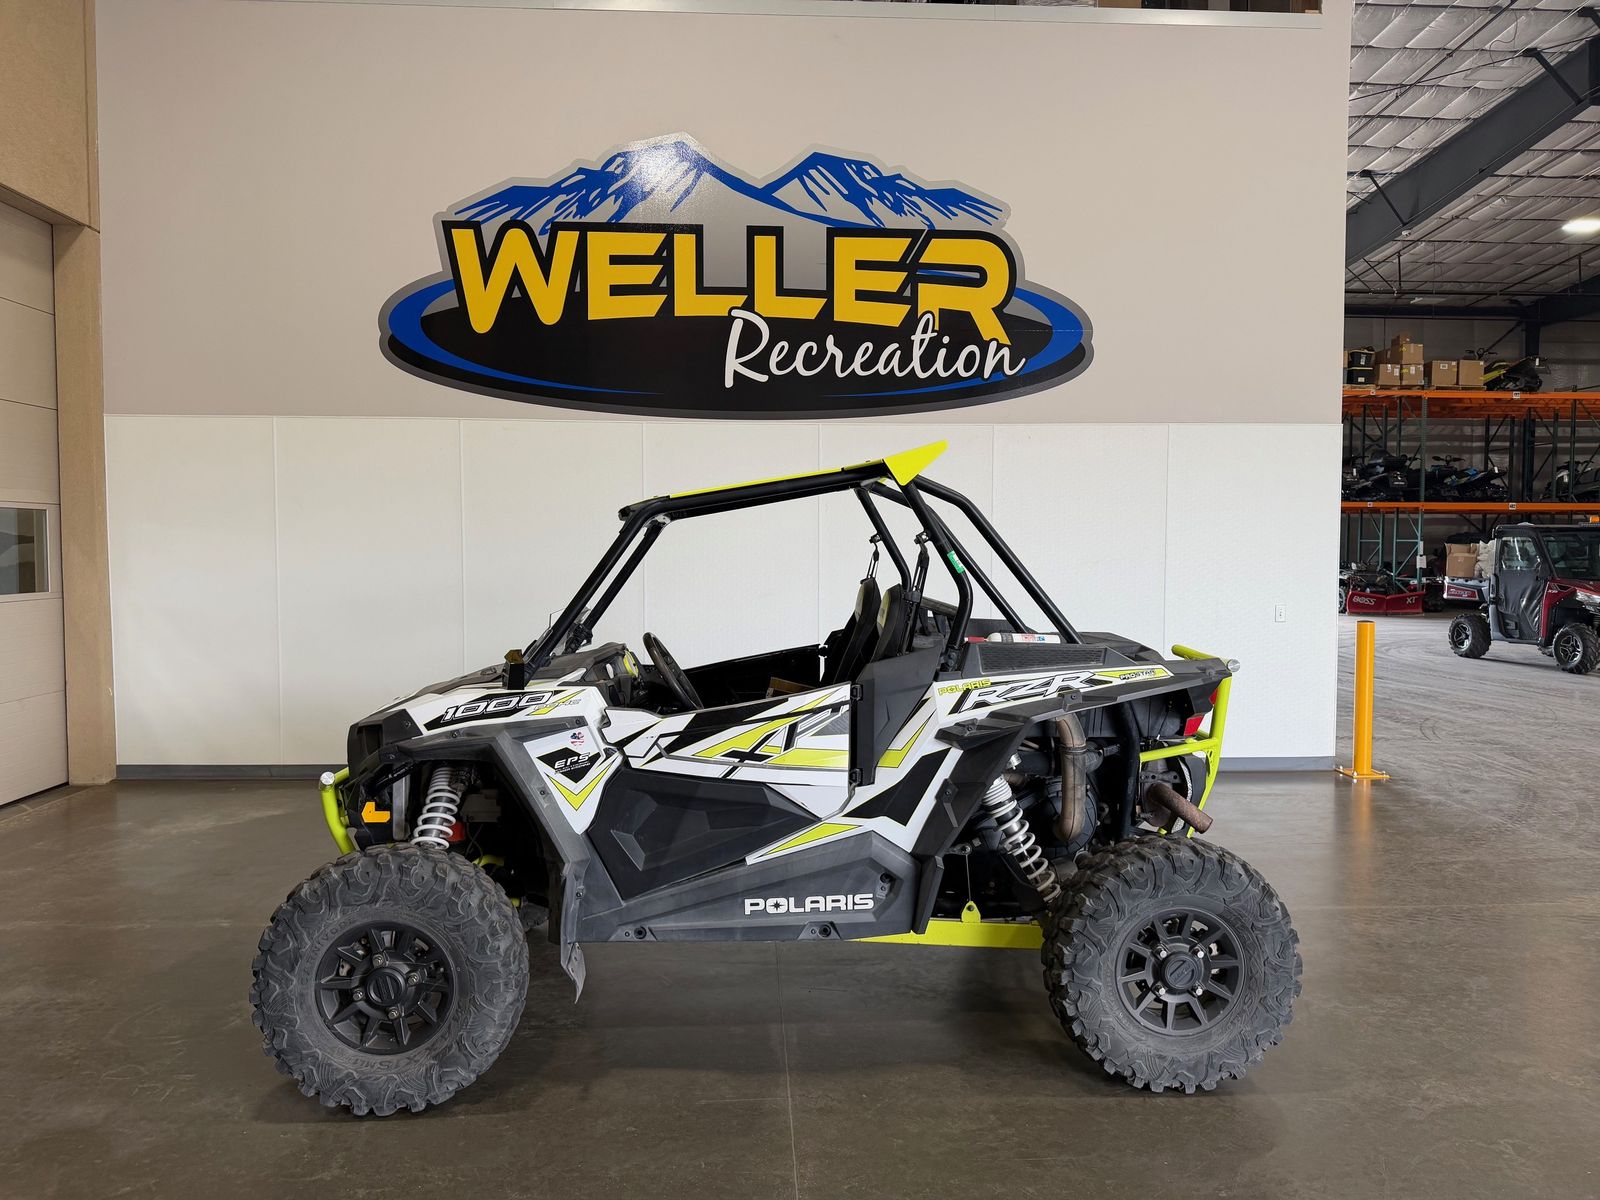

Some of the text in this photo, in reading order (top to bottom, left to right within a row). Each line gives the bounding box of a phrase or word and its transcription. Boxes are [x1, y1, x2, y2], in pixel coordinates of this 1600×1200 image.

[449, 226, 1012, 346] WELLER
[724, 308, 1026, 389] Recreation
[938, 678, 992, 696] POLARIS
[957, 670, 1097, 714] RZR
[440, 691, 555, 724] 1000
[554, 751, 591, 769] EPS
[744, 893, 875, 915] POLARIS
